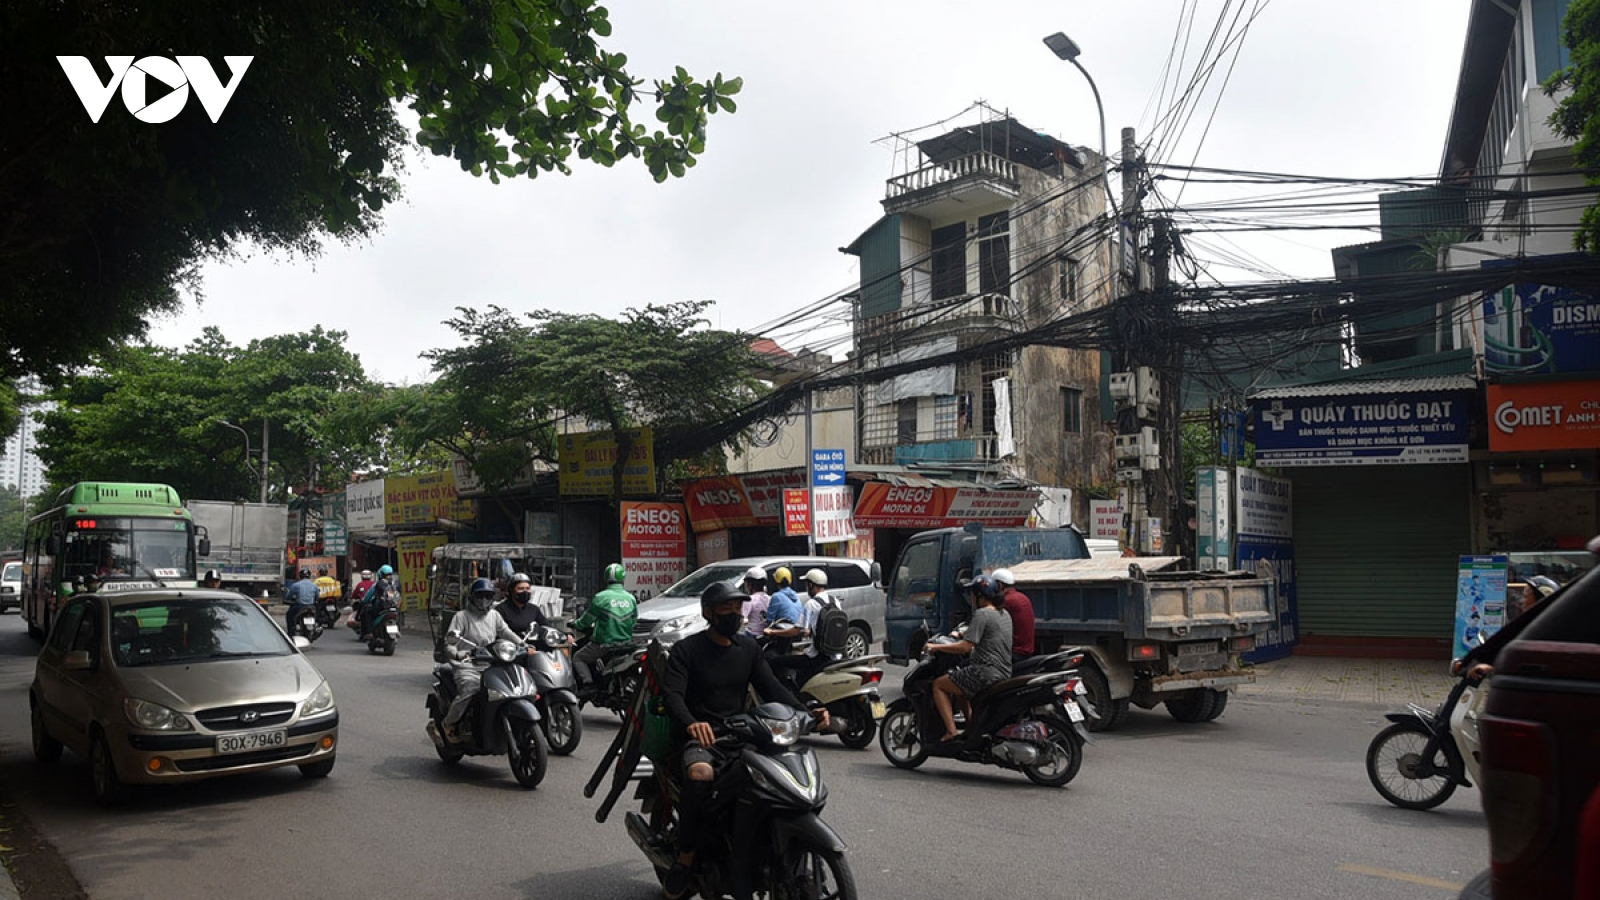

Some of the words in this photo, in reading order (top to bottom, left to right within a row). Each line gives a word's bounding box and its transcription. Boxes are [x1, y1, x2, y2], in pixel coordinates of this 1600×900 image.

[1352, 399, 1411, 420] THUỐC
[1416, 401, 1452, 422] ĐẠT
[1494, 401, 1563, 433] COMET
[815, 493, 834, 511] MUA
[886, 486, 934, 503] ENEOS
[627, 509, 680, 524] ENEOS
[881, 504, 913, 514] MOTOR
[913, 504, 927, 514] OIL
[628, 525, 662, 534] MOTOR
[664, 525, 681, 534] OIL
[816, 520, 826, 538] XE
[828, 515, 844, 537] MÁY
[626, 562, 653, 572] HONDA
[655, 562, 684, 572] MOTOR
[636, 574, 653, 585] ANH
[610, 599, 630, 608] Grab
[222, 732, 282, 751] 30X-7946
